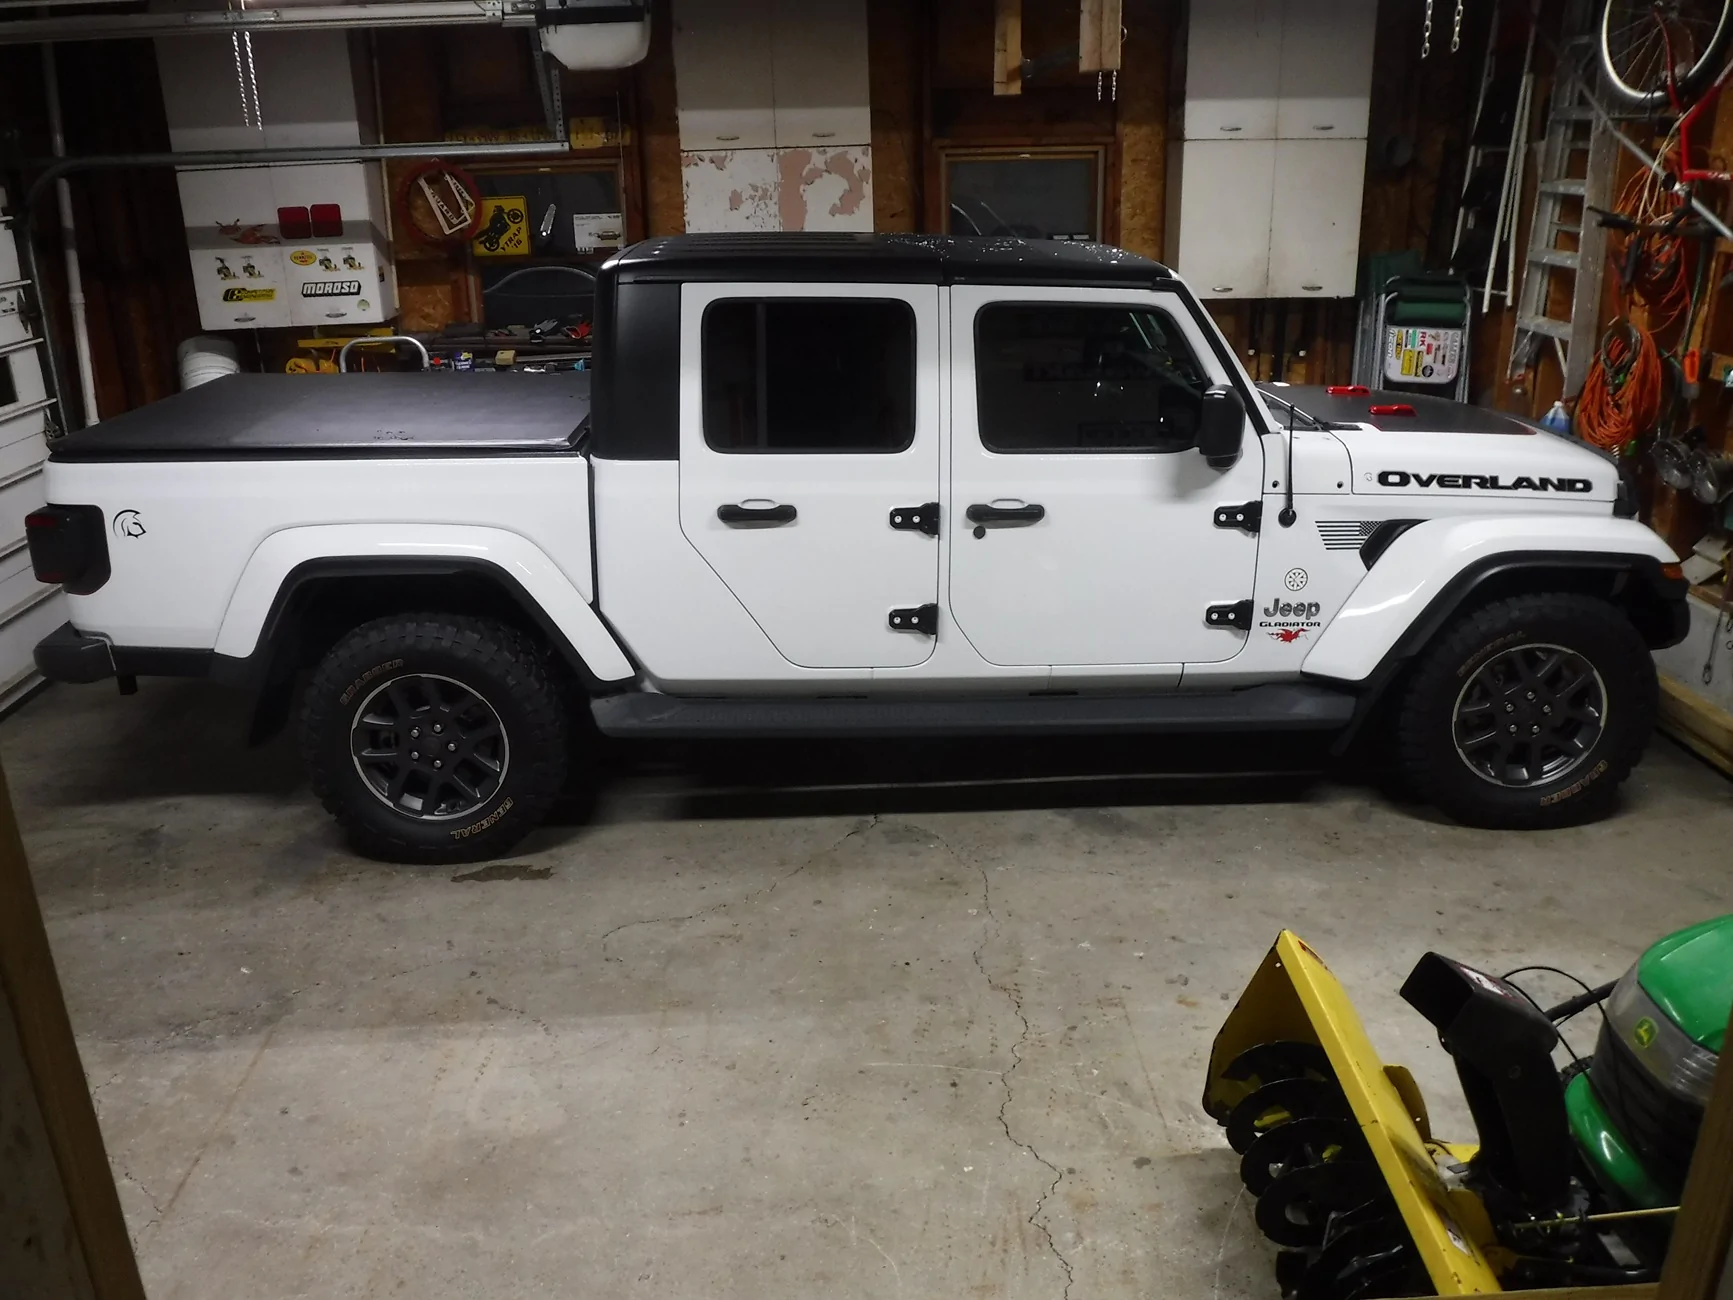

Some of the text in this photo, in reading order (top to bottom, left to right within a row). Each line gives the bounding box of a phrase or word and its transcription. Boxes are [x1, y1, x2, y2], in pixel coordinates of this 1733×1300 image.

[302, 281, 360, 295] MOROSO
[1377, 470, 1593, 493] OVERLAND
[1264, 598, 1320, 620] Jeep
[450, 796, 514, 840] GENERAL
